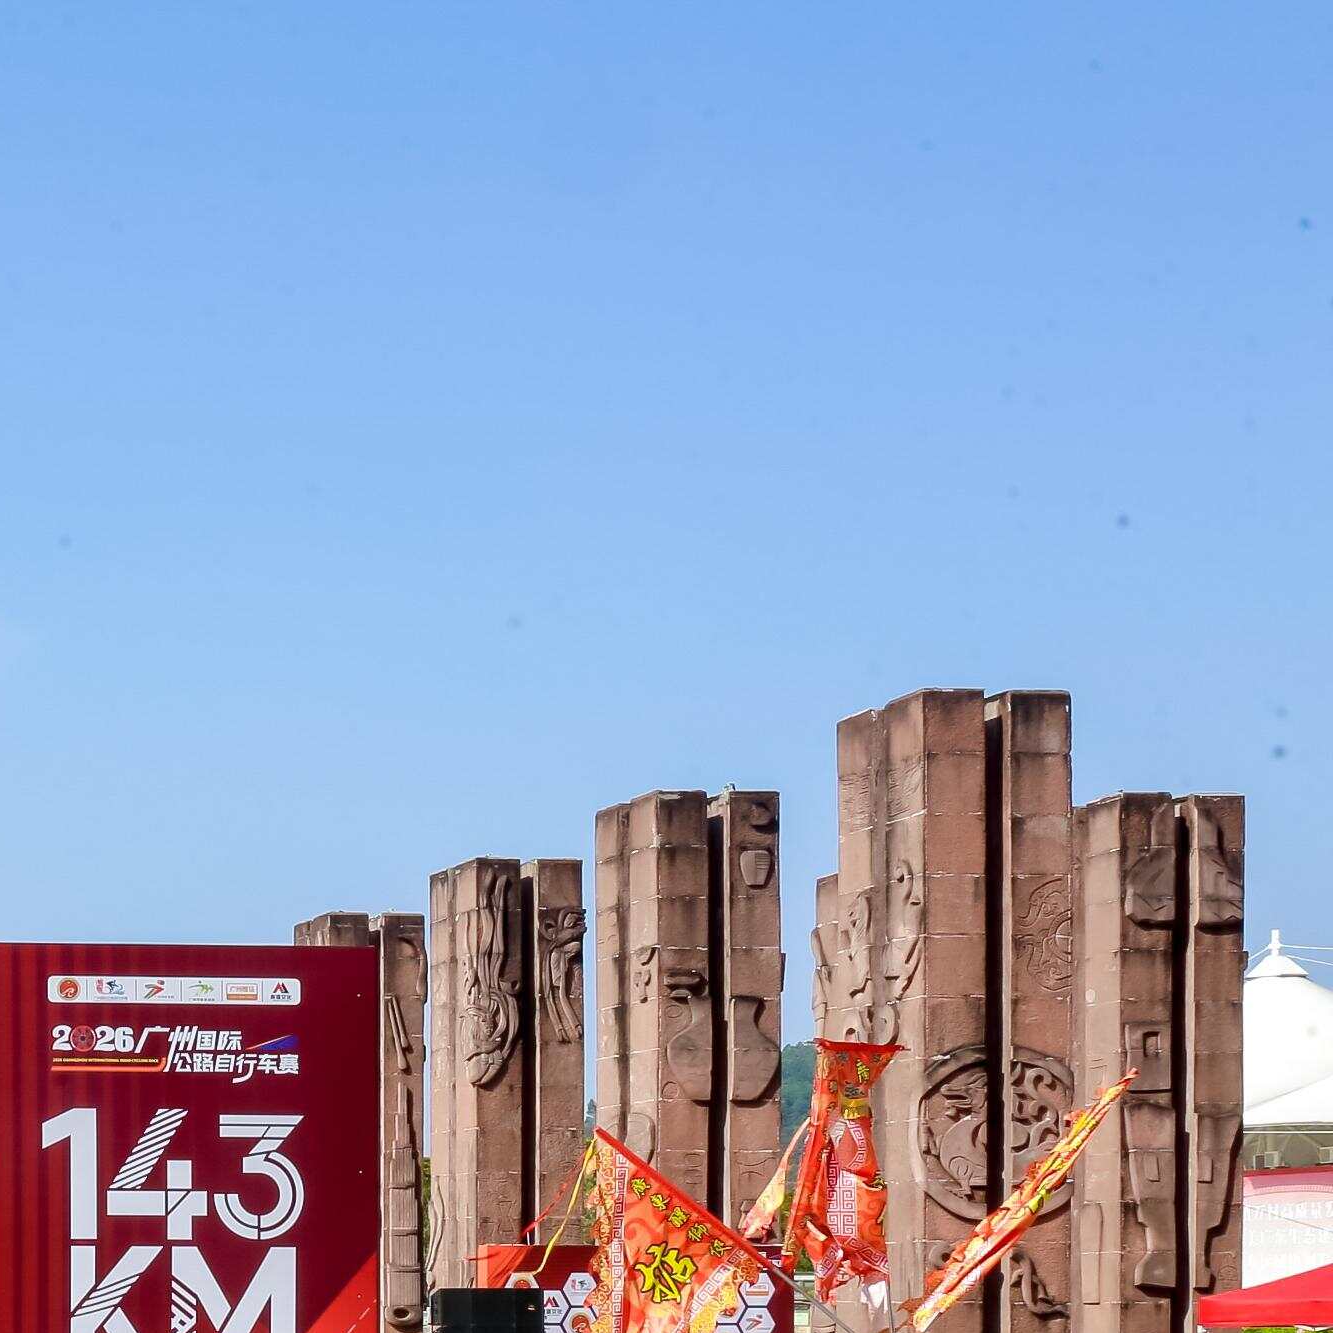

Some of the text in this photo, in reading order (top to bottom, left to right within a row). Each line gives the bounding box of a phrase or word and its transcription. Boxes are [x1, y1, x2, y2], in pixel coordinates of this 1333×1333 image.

[172, 1053, 299, 1084] 公路自行车赛
[41, 1106, 306, 1241] 143
